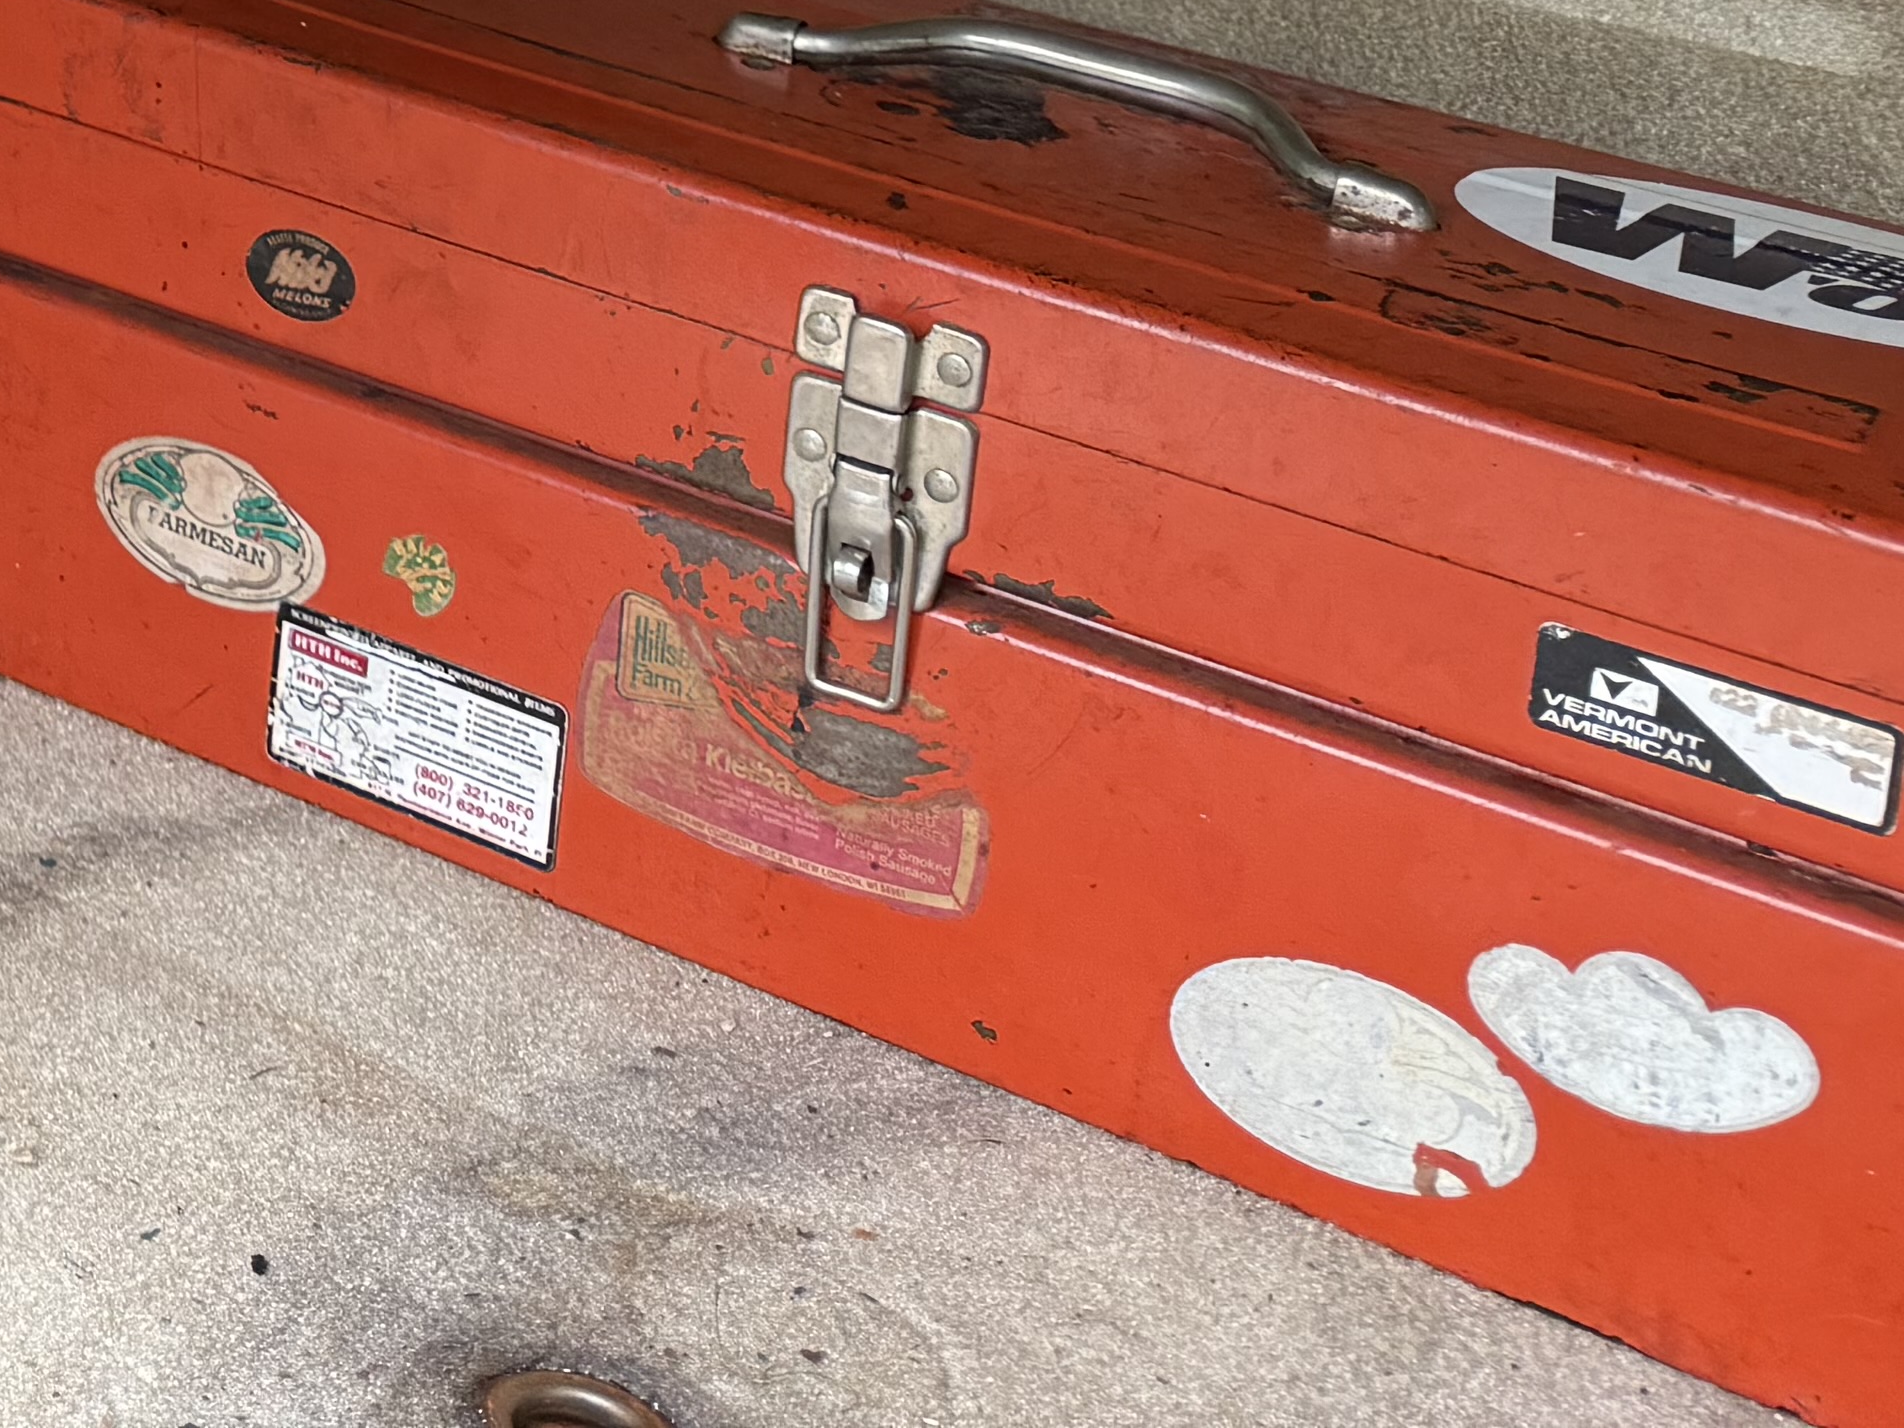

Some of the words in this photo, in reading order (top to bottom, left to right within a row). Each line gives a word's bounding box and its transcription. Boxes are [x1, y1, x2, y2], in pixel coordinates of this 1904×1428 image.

[293, 632, 331, 660] HTH
[332, 647, 364, 673] Inc.
[295, 669, 324, 691] HTH
[630, 662, 682, 699] Farm
[1538, 707, 1713, 774] AMERICAN
[1542, 687, 1706, 750] VERMONT
[412, 778, 452, 810] (407)
[455, 796, 528, 839] 629-0012
[414, 761, 454, 793] (800)
[461, 780, 534, 823] 321-1850
[834, 838, 875, 862] Polish
[878, 854, 937, 886] Sausage
[837, 829, 895, 858] Naturally
[898, 846, 953, 877] Smoked
